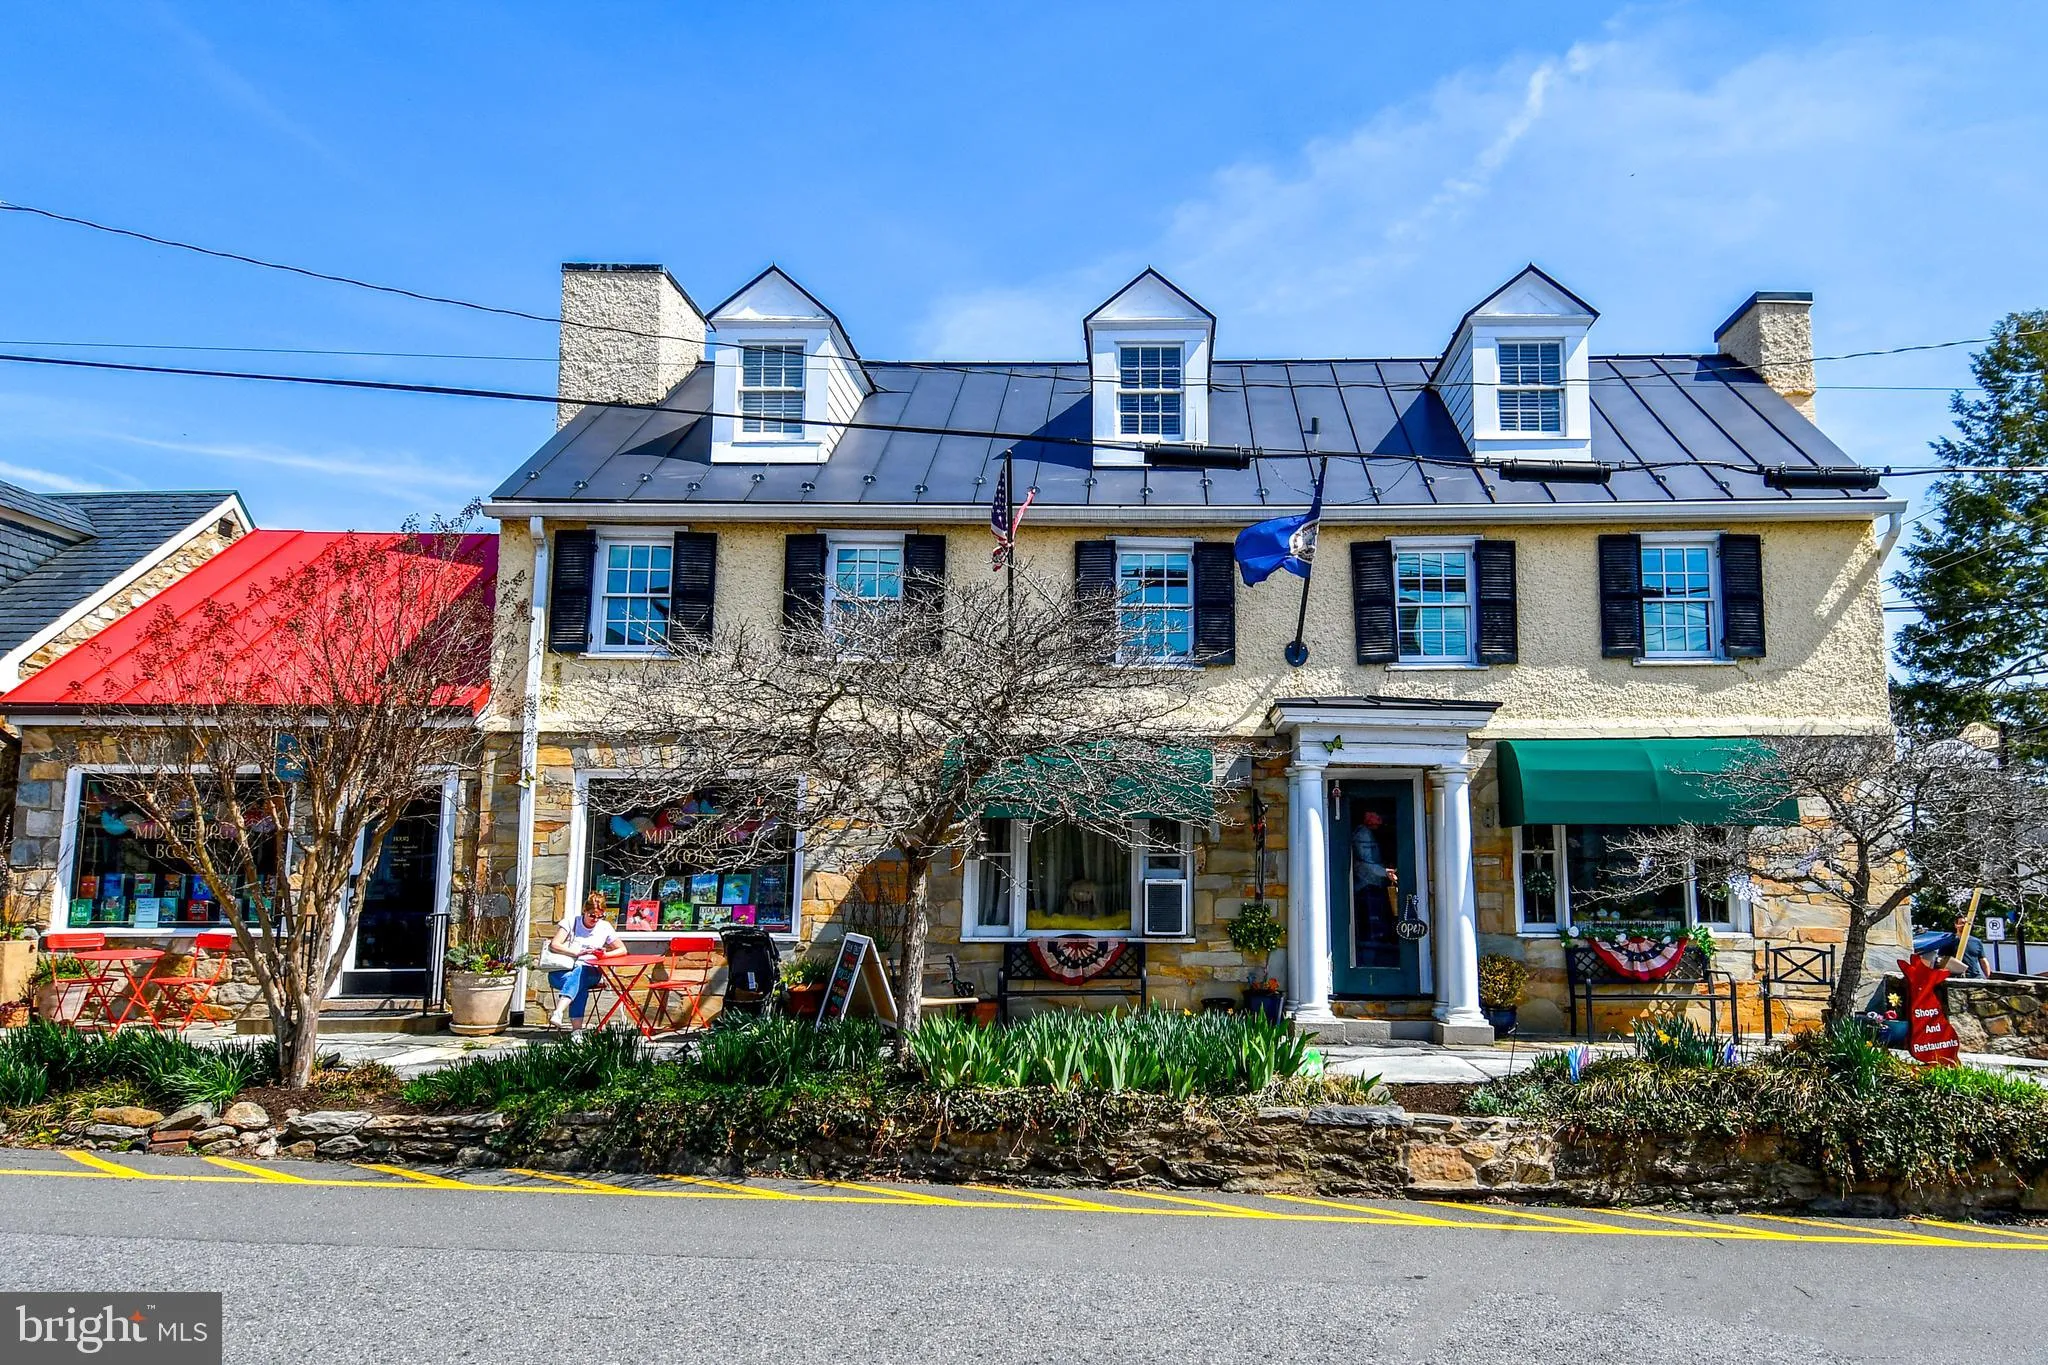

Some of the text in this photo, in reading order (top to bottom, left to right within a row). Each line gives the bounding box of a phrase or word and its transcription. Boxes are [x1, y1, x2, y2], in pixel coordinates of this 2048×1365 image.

[155, 843, 206, 859] BOK
[1915, 1008, 1938, 1018] Shops
[1926, 1023, 1940, 1033] And
[1914, 1039, 1958, 1052] Restaurants
